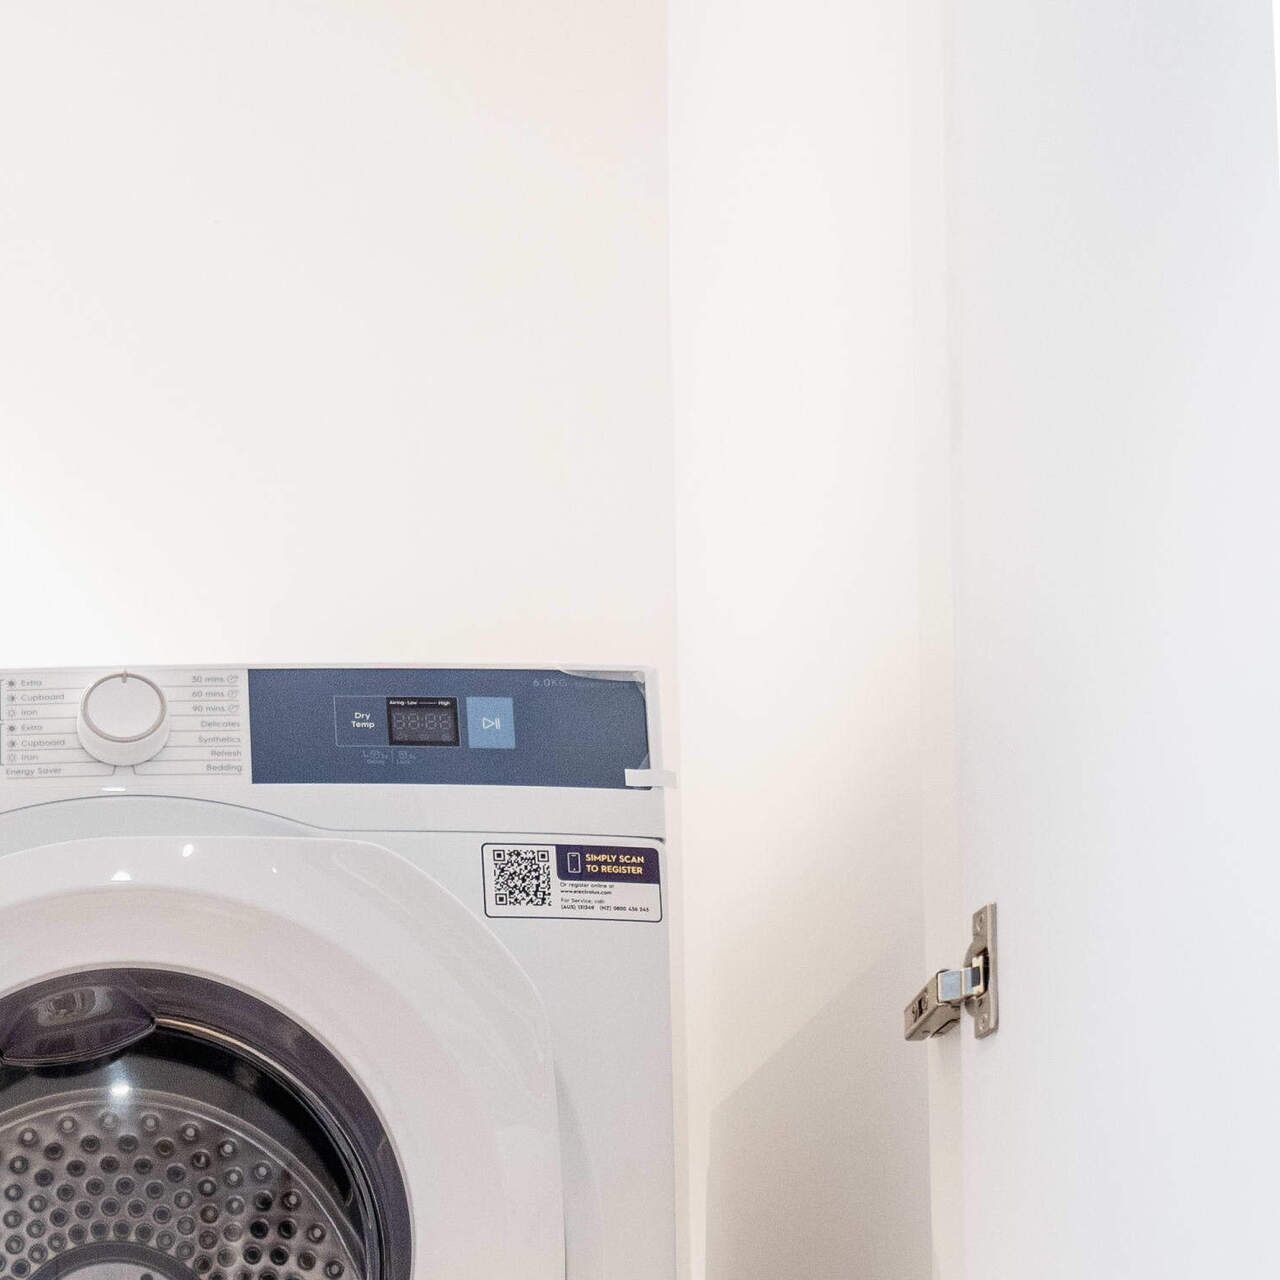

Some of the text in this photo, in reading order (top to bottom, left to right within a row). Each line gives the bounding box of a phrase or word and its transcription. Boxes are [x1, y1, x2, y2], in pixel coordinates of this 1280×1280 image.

[192, 675, 202, 683] 30
[20, 694, 65, 702] Cupboard
[192, 690, 203, 698] 60
[192, 704, 203, 713] 90
[354, 712, 371, 720] Dry
[200, 720, 240, 728] Delicates
[351, 721, 375, 729] Temp
[20, 739, 65, 747] Cupboard
[198, 735, 241, 744] Synthetics
[6, 768, 35, 776] Energy
[585, 853, 645, 864] SIMPLY SCAN
[586, 864, 643, 875] TO REGISTER
